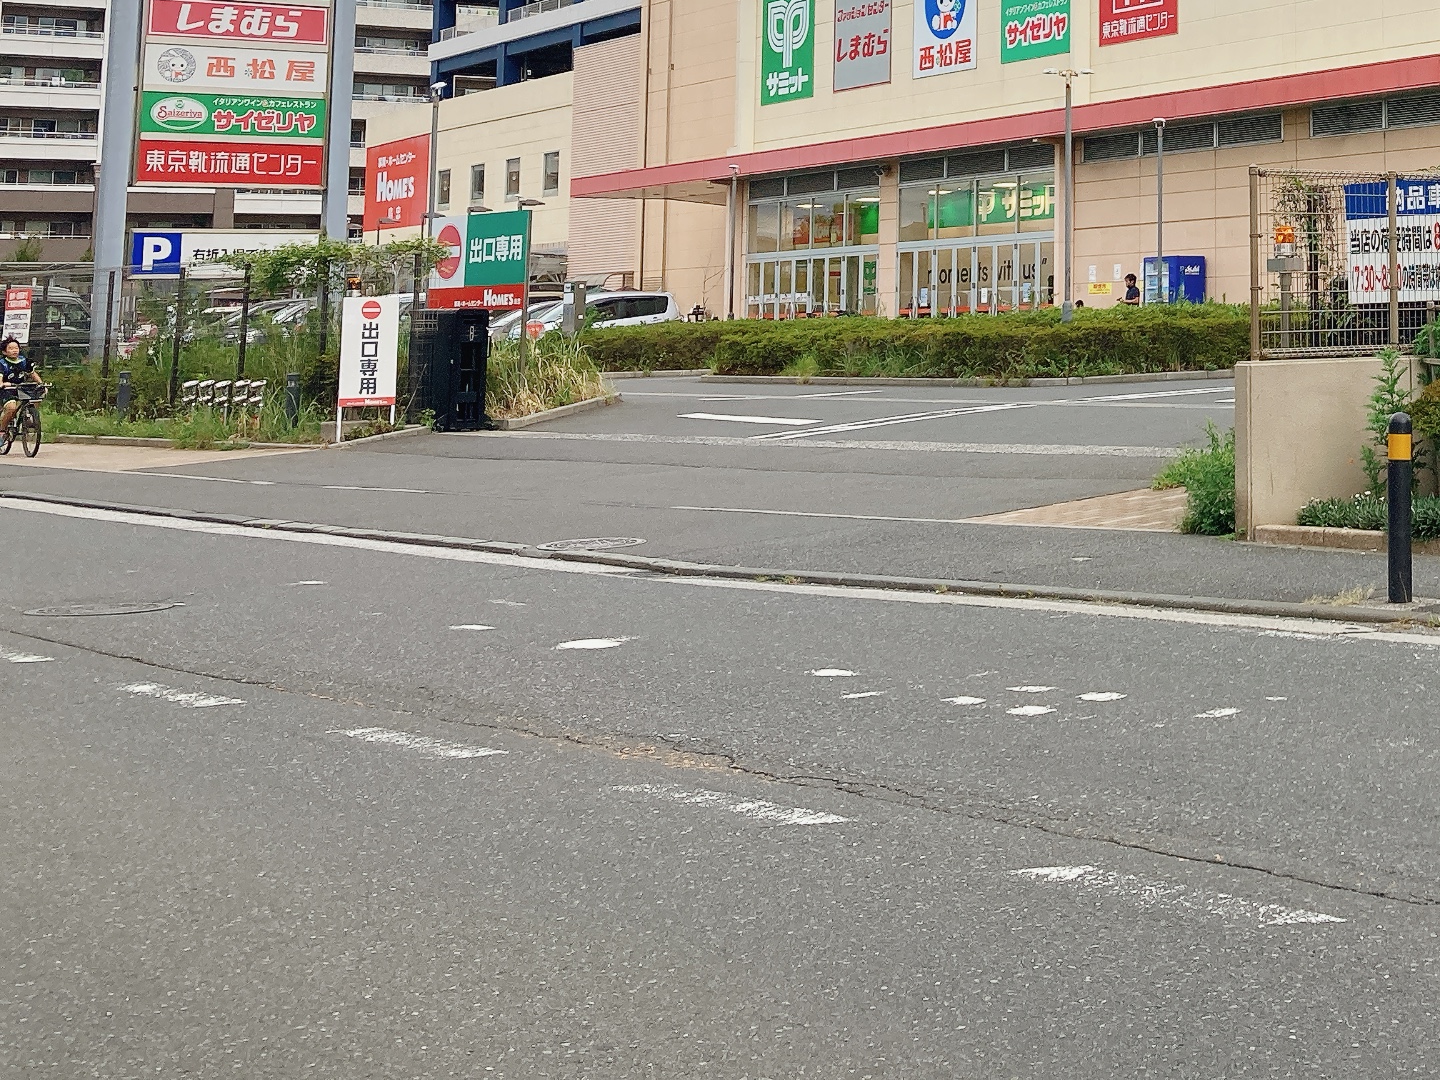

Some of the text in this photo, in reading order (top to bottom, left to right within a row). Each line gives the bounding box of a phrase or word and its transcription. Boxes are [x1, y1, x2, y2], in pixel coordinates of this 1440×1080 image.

[176, 3, 303, 38] しまむら
[1005, 11, 1069, 49] サイゼリヤ
[1102, 11, 1175, 39] 東京靴流通センター
[836, 28, 889, 63] しまむら
[919, 38, 972, 71] 西松屋
[206, 56, 316, 82] 西松屋
[766, 67, 808, 97] サミット
[156, 105, 203, 121] Saizeriya
[212, 109, 317, 134] サイゼリヤ
[145, 150, 317, 176] 東京靴流通センター
[141, 236, 173, 271] P
[469, 234, 523, 264] 出口専用
[483, 289, 514, 307] HOME'S
[358, 321, 379, 395] 出口専用
